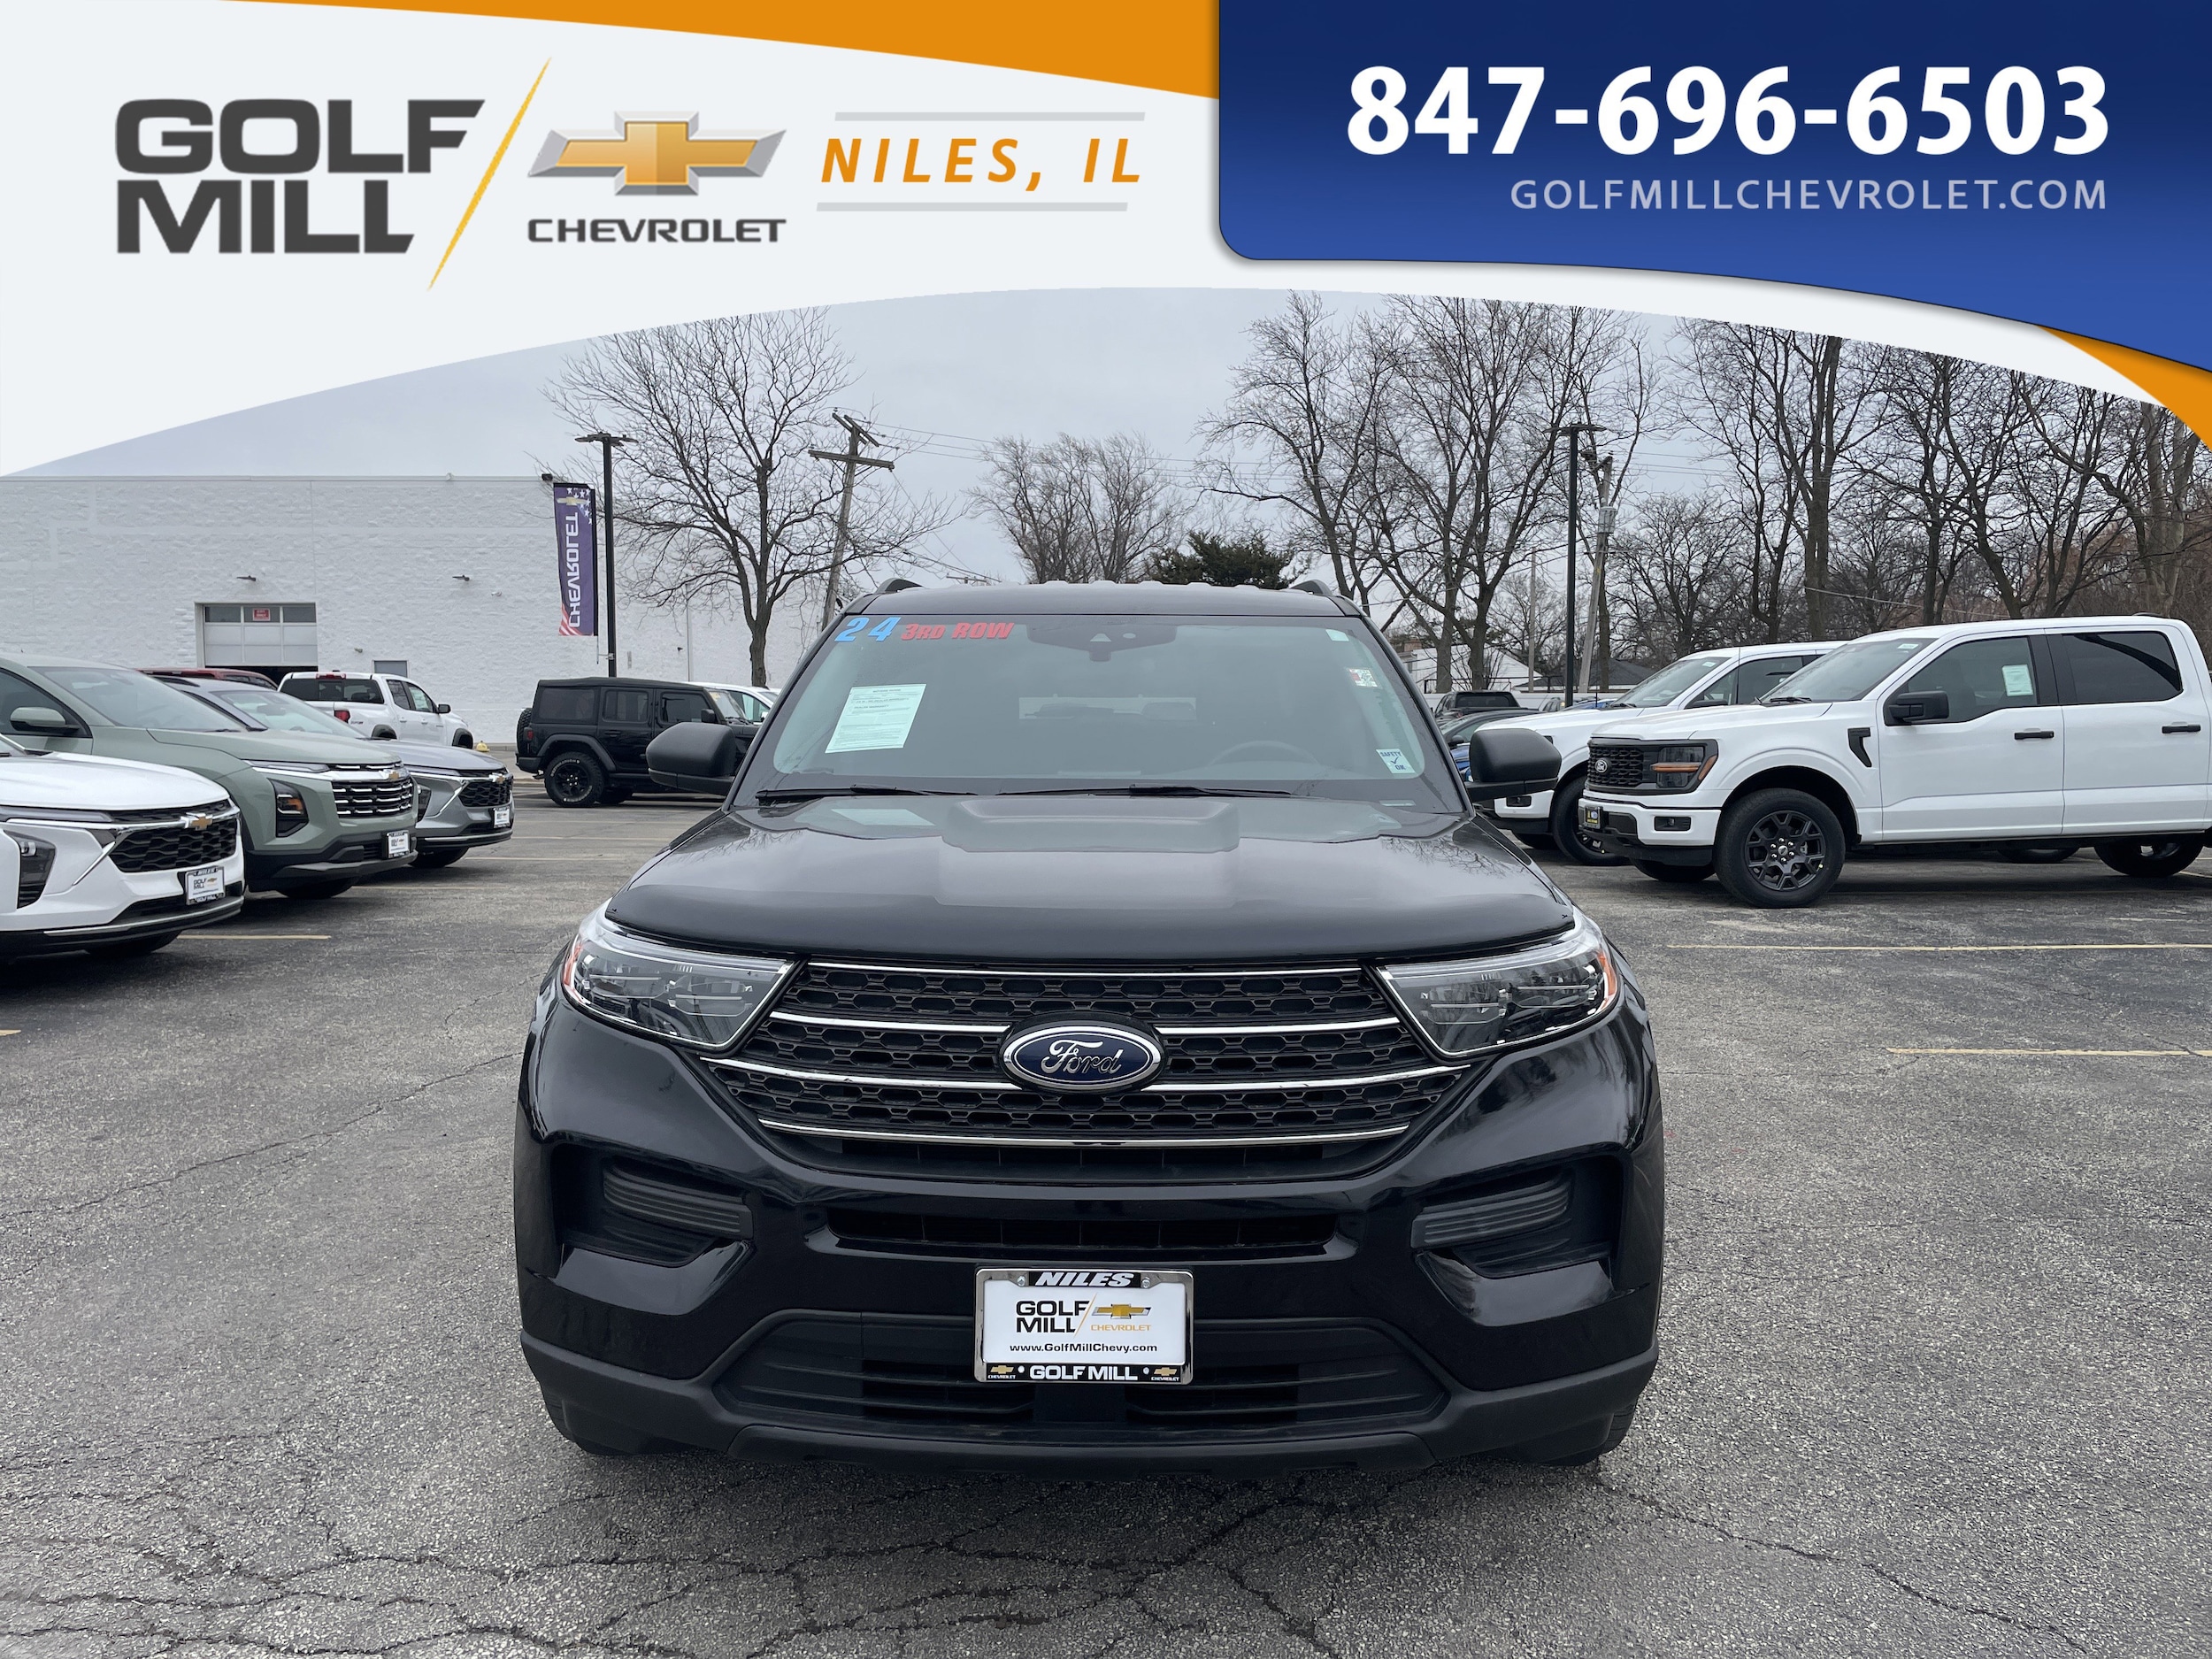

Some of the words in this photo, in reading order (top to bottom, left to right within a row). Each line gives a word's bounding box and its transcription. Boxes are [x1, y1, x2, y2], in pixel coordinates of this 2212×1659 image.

[901, 623, 945, 641] 3RD
[951, 622, 1015, 640] ROW
[1041, 1039, 1124, 1074] Ford
[1035, 1271, 1134, 1287] NILES
[1016, 1301, 1090, 1317] GOLF
[1017, 1317, 1077, 1333] MILL
[1010, 1342, 1157, 1354] www.GolfMillChevy.com
[1029, 1365, 1087, 1379] GOLF
[1088, 1367, 1138, 1380] MILL
